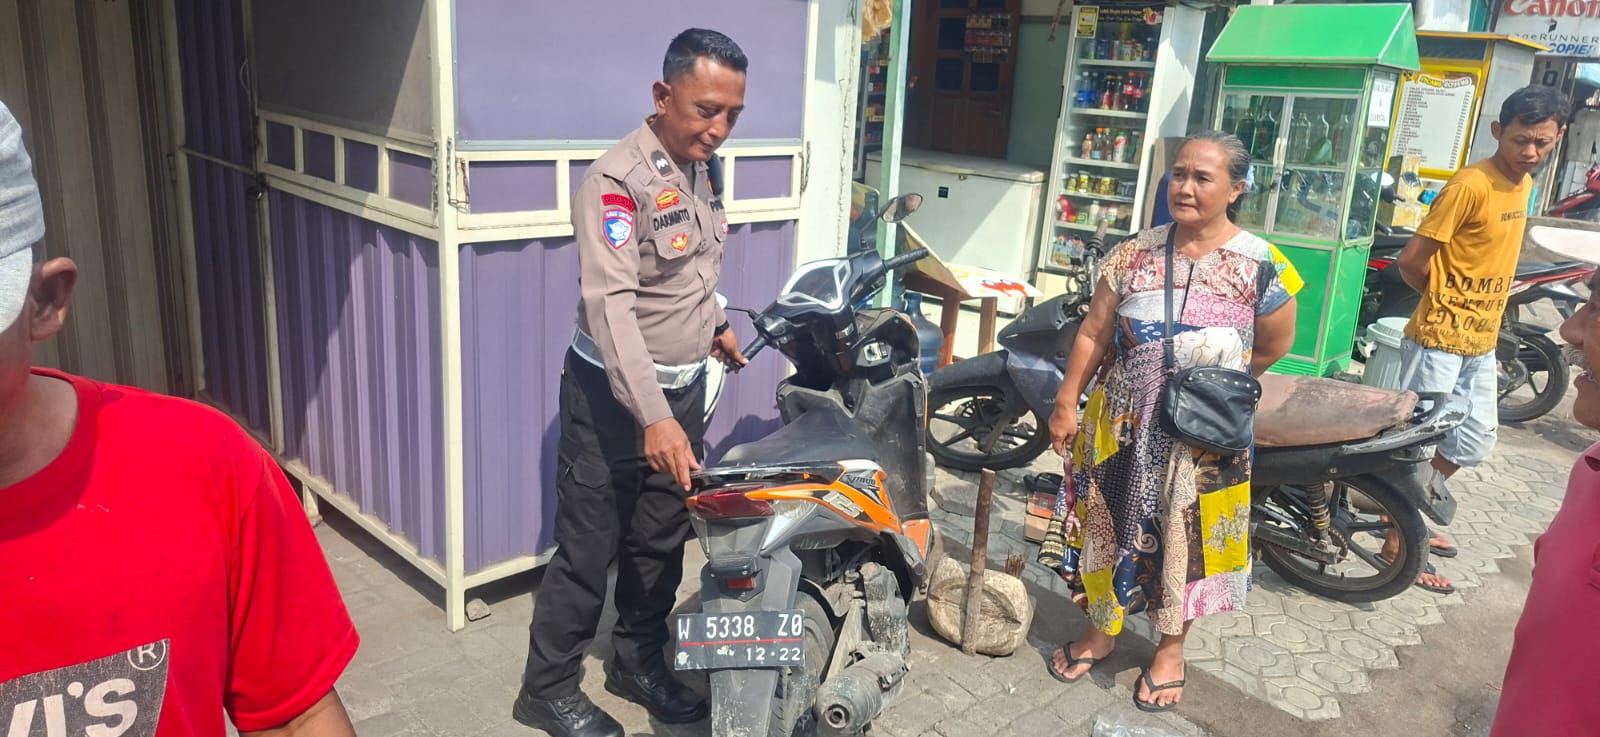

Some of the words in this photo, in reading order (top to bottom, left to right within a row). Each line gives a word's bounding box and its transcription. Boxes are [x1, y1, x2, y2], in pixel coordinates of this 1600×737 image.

[822, 491, 864, 517] 125
[678, 618, 690, 640] W
[706, 615, 754, 639] 5338
